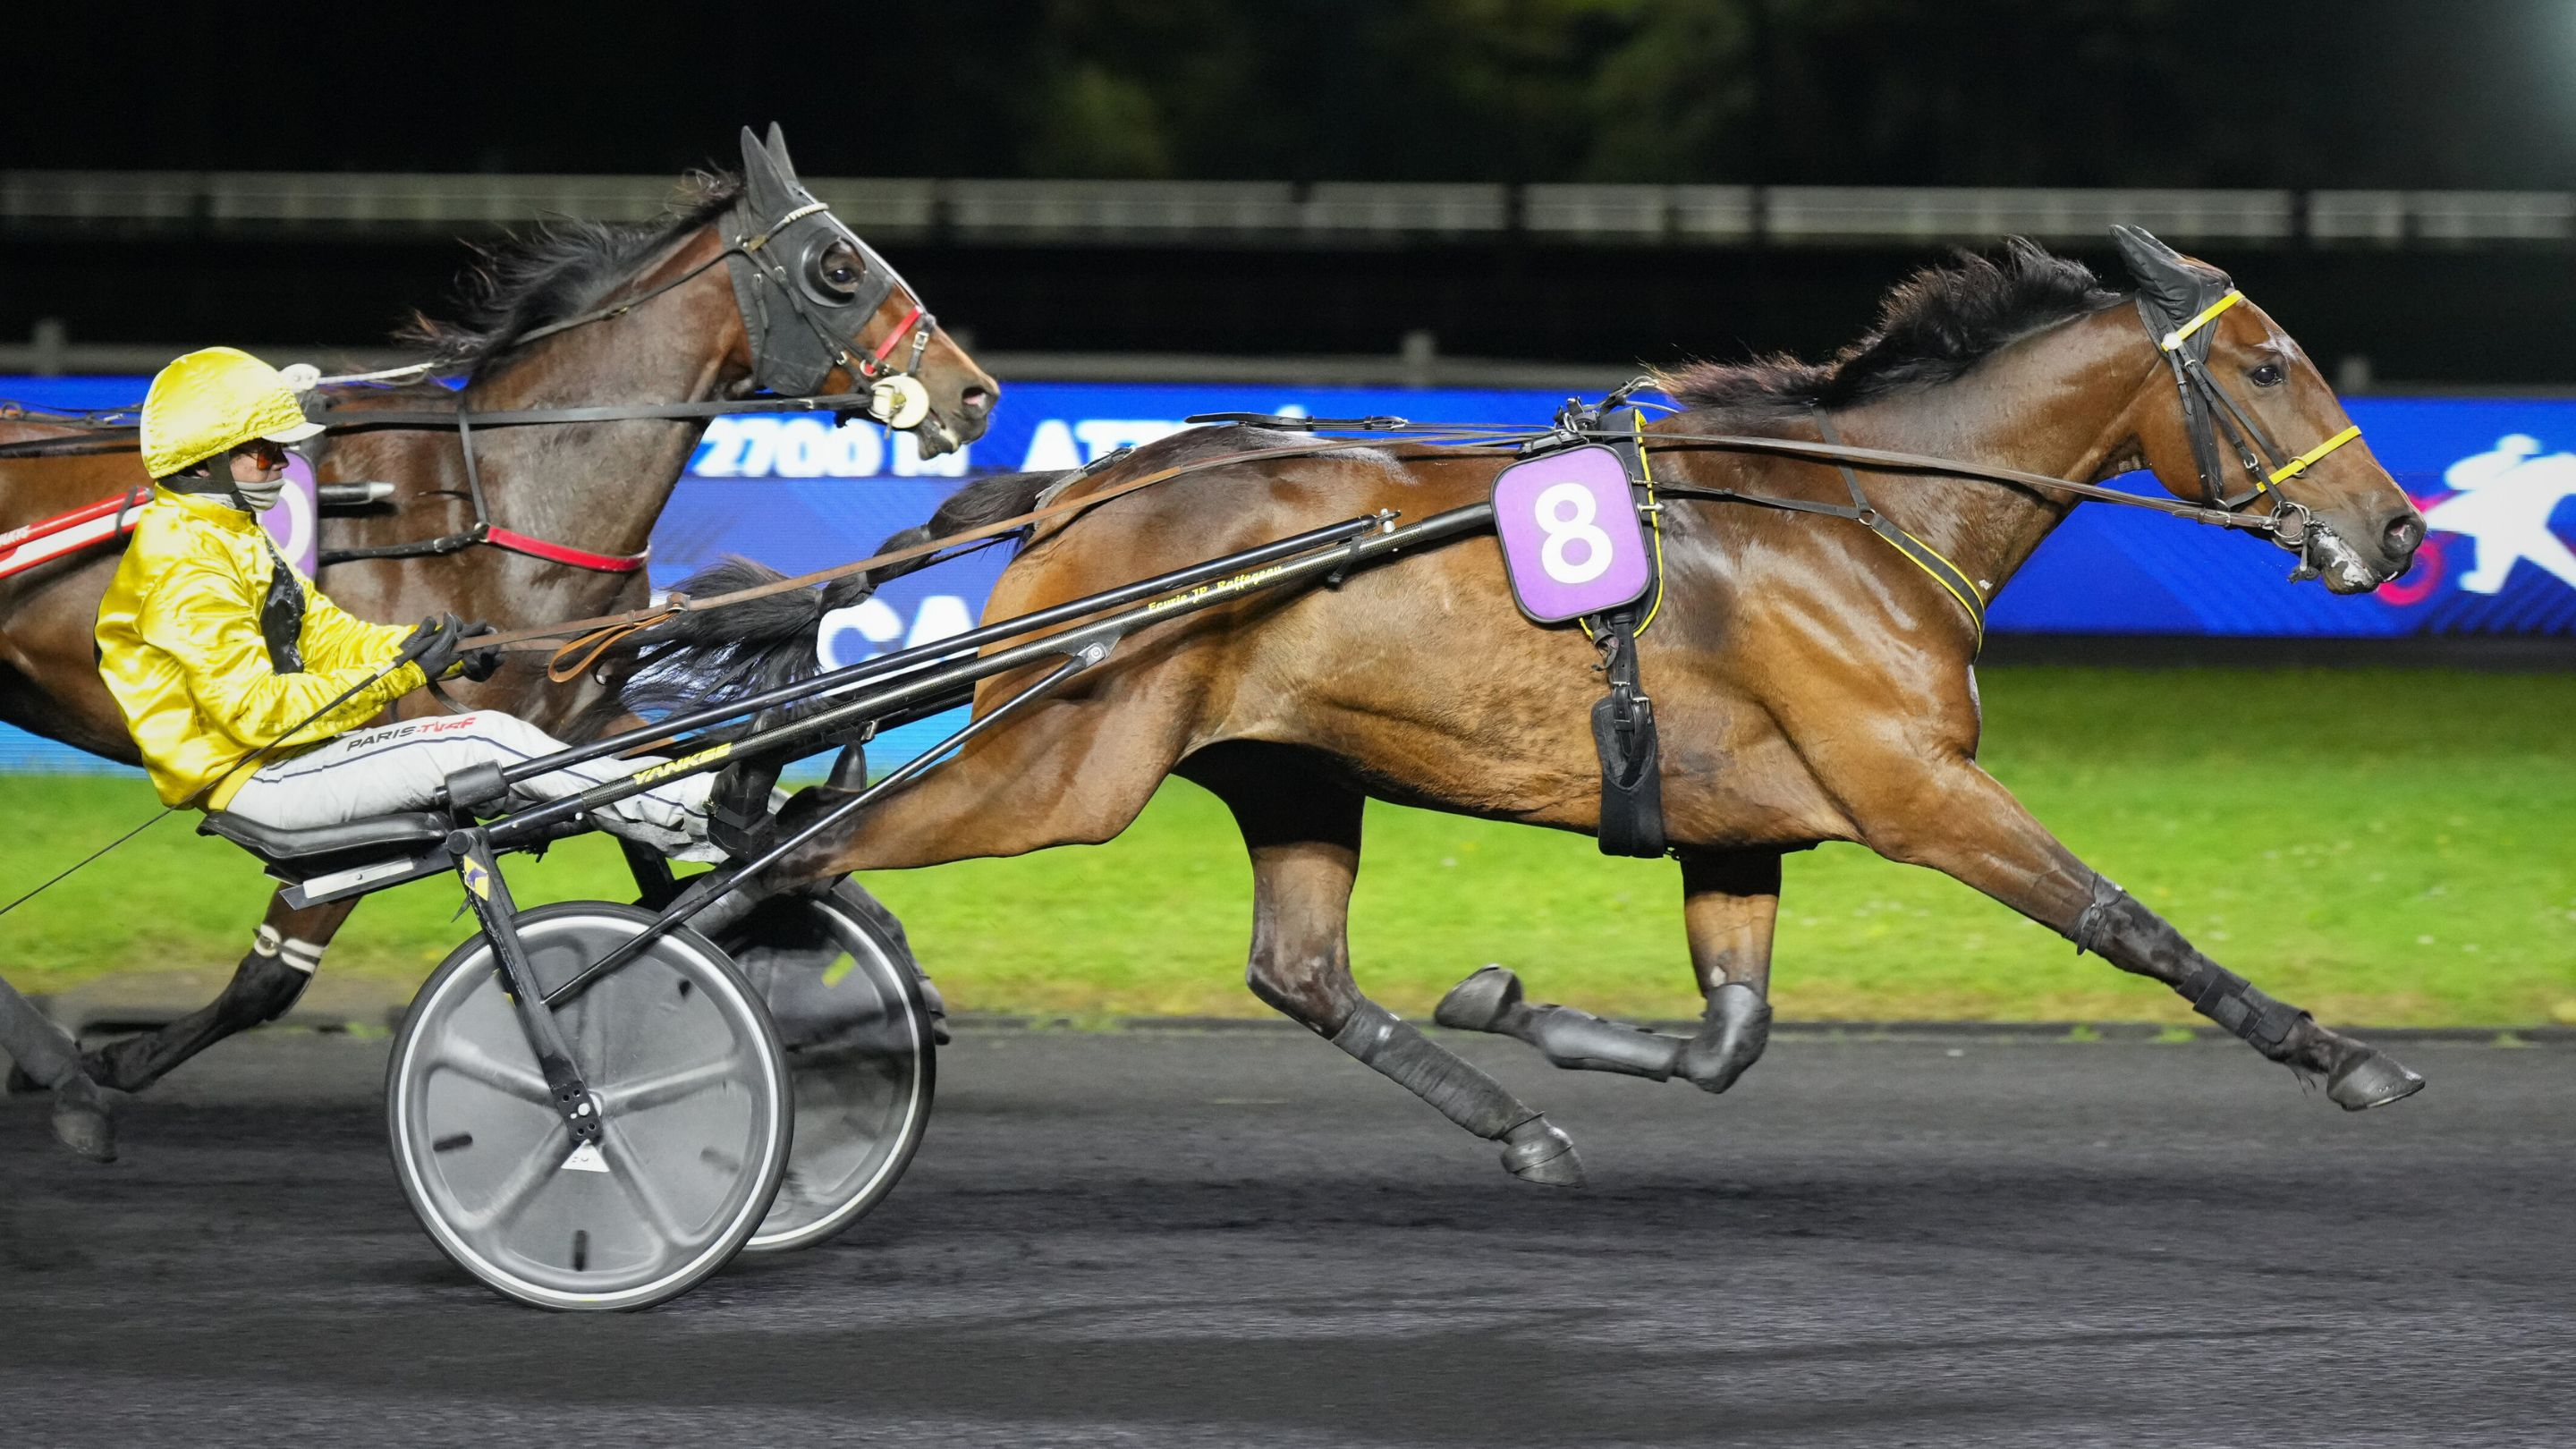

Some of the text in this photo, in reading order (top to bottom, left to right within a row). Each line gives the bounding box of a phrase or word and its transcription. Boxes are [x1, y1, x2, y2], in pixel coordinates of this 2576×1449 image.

[693, 417, 883, 477] 2700
[1535, 482, 1614, 584] 8
[632, 741, 733, 785] YANKEE
